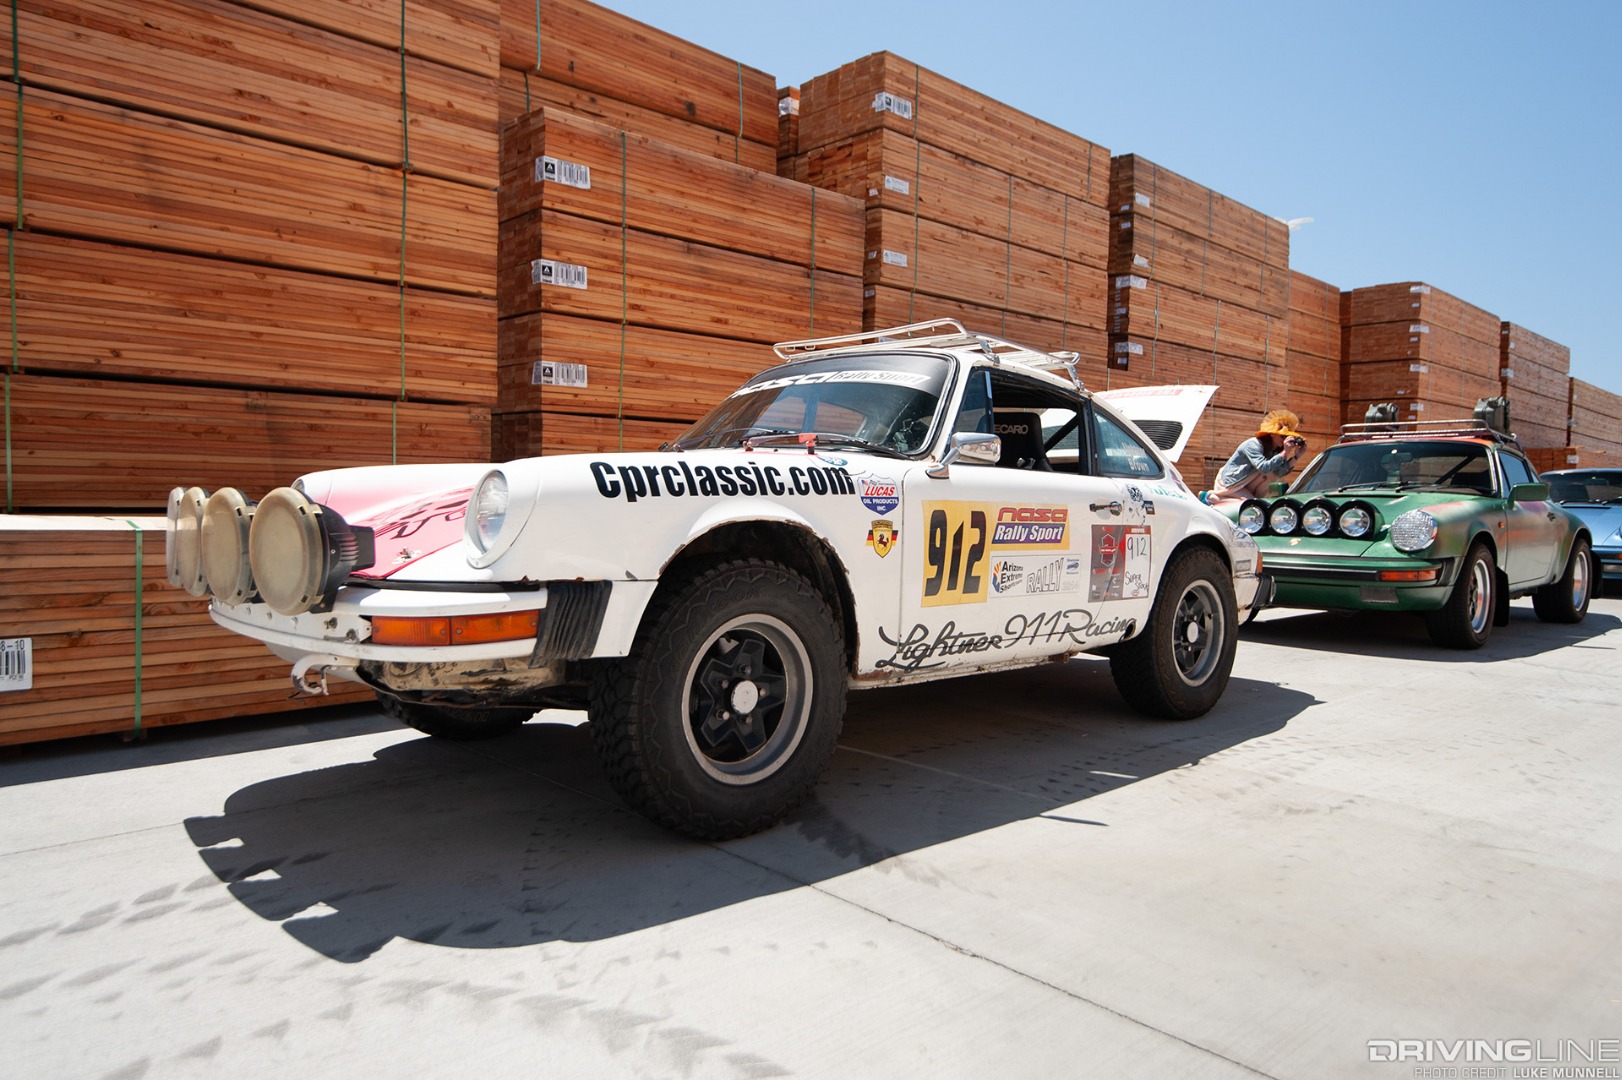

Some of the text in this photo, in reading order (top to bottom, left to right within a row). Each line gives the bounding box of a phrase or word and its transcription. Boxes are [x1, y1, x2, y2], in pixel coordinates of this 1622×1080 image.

[834, 372, 870, 382] Rally
[875, 373, 926, 383] Sport
[993, 424, 1029, 435] ECARO
[590, 461, 856, 502] Cprclassic.com
[865, 486, 896, 496] LUCAS
[998, 507, 1069, 522] nasa
[995, 524, 1063, 542] Rally Sport
[924, 509, 987, 597] 912
[1127, 537, 1146, 560] 912
[1001, 561, 1023, 572] Arizona
[1026, 557, 1064, 593] RALLY
